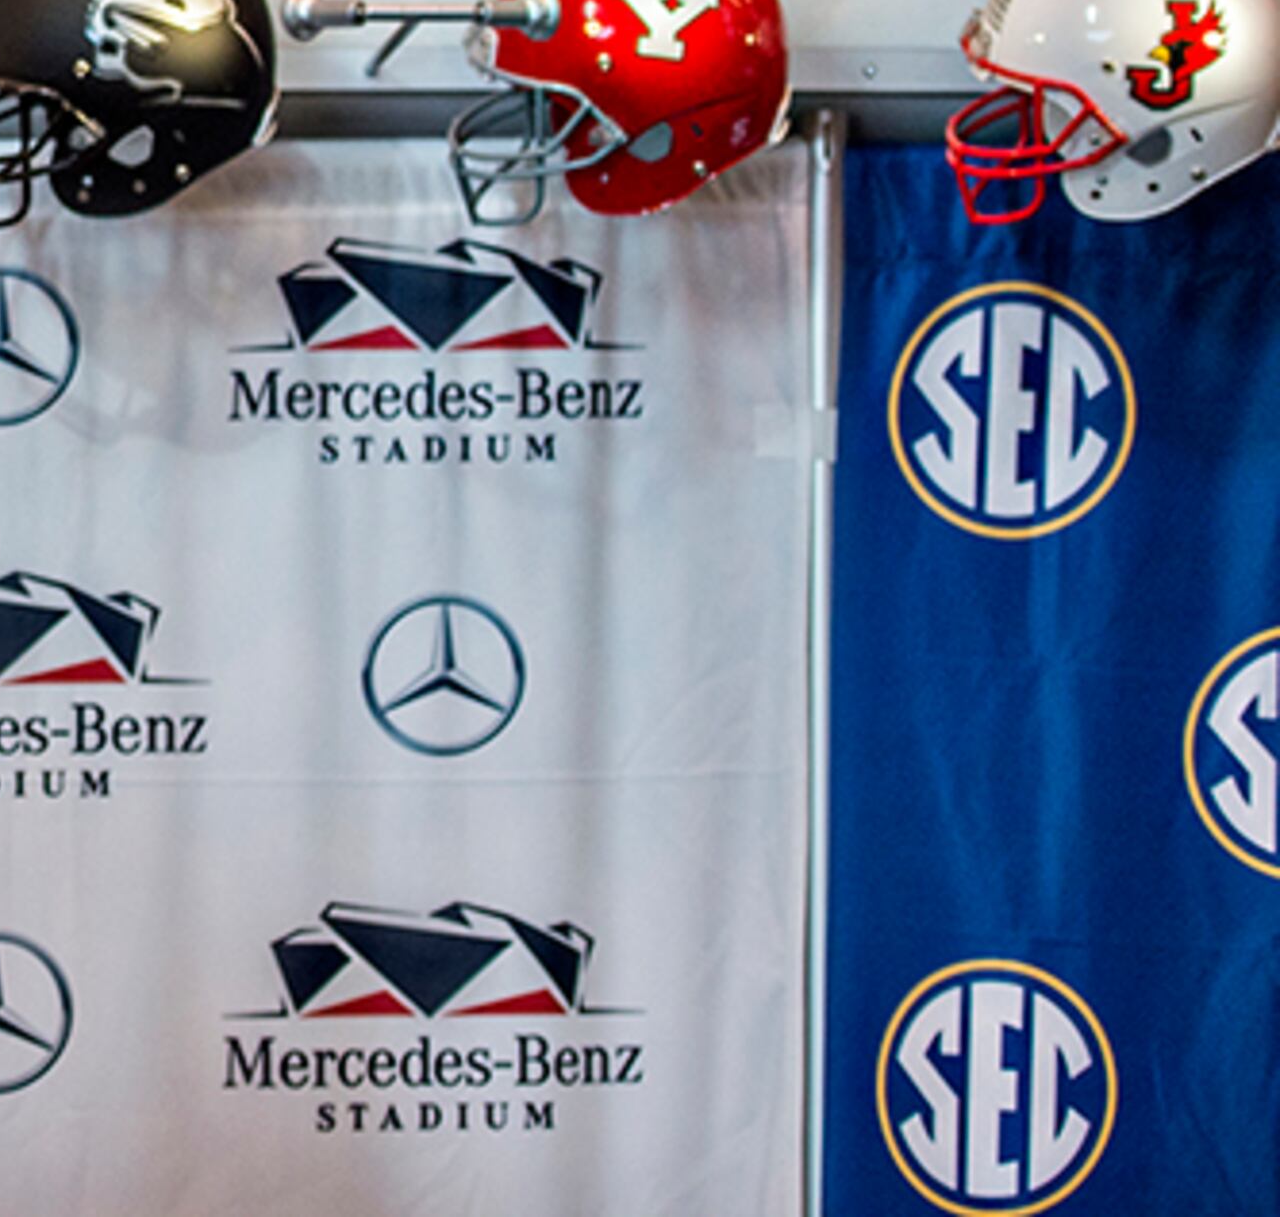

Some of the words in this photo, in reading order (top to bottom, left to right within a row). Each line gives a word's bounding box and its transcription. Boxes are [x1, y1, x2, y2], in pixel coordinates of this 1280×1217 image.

[229, 367, 643, 422] Mercedes-Benz
[912, 302, 1111, 518] SEC
[319, 433, 556, 463] STADIUM
[223, 1034, 644, 1091] Mercedes-Benz
[895, 981, 1093, 1199] SEC
[315, 1100, 555, 1134] STADIUM
